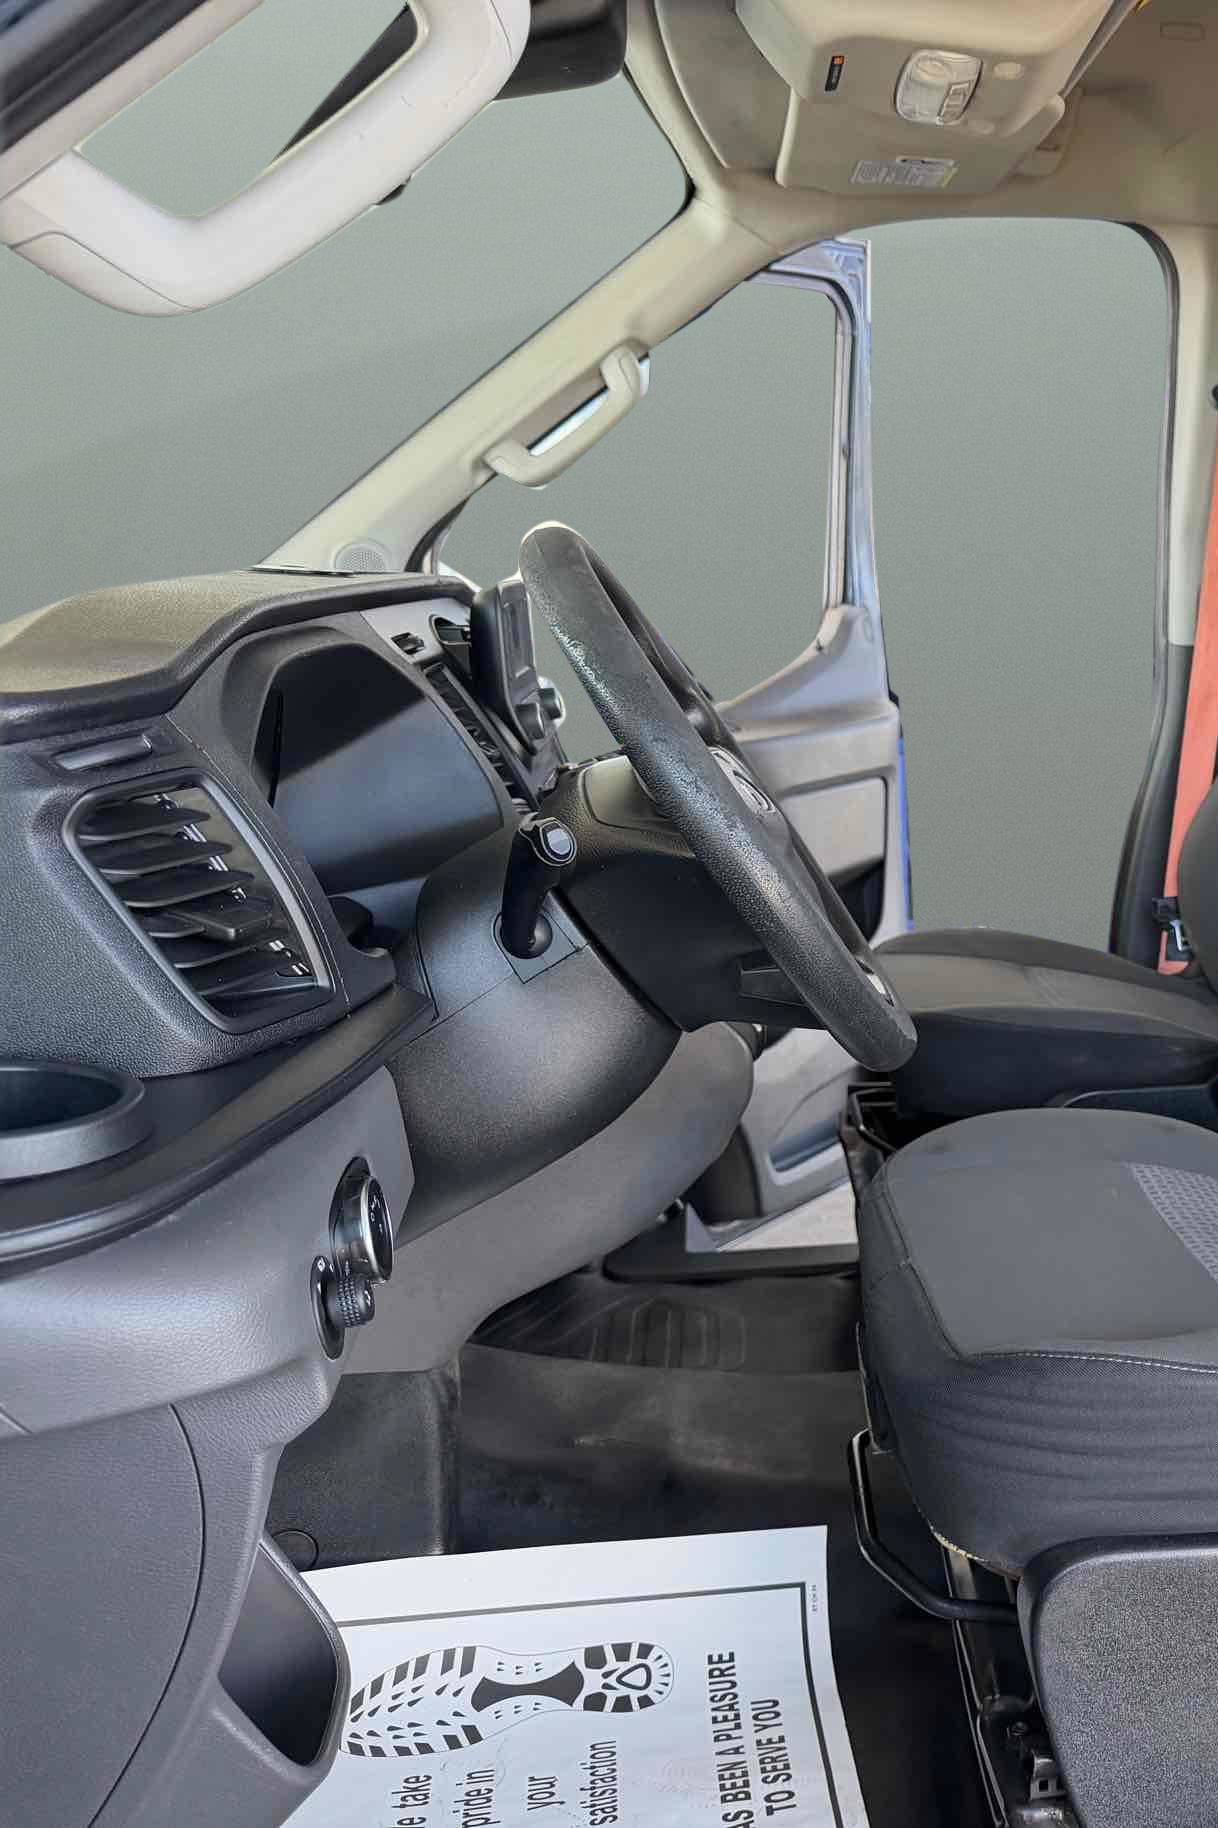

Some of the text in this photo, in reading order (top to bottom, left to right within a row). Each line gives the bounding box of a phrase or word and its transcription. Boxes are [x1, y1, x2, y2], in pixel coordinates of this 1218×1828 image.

[707, 1651, 755, 1828] AS BEEN A PLEASURE
[750, 1698, 797, 1817] TO SERVE YOU
[391, 1774, 433, 1828] e take
[452, 1768, 502, 1828] pride in
[527, 1775, 566, 1811] your
[579, 1740, 619, 1827] satisfaction
